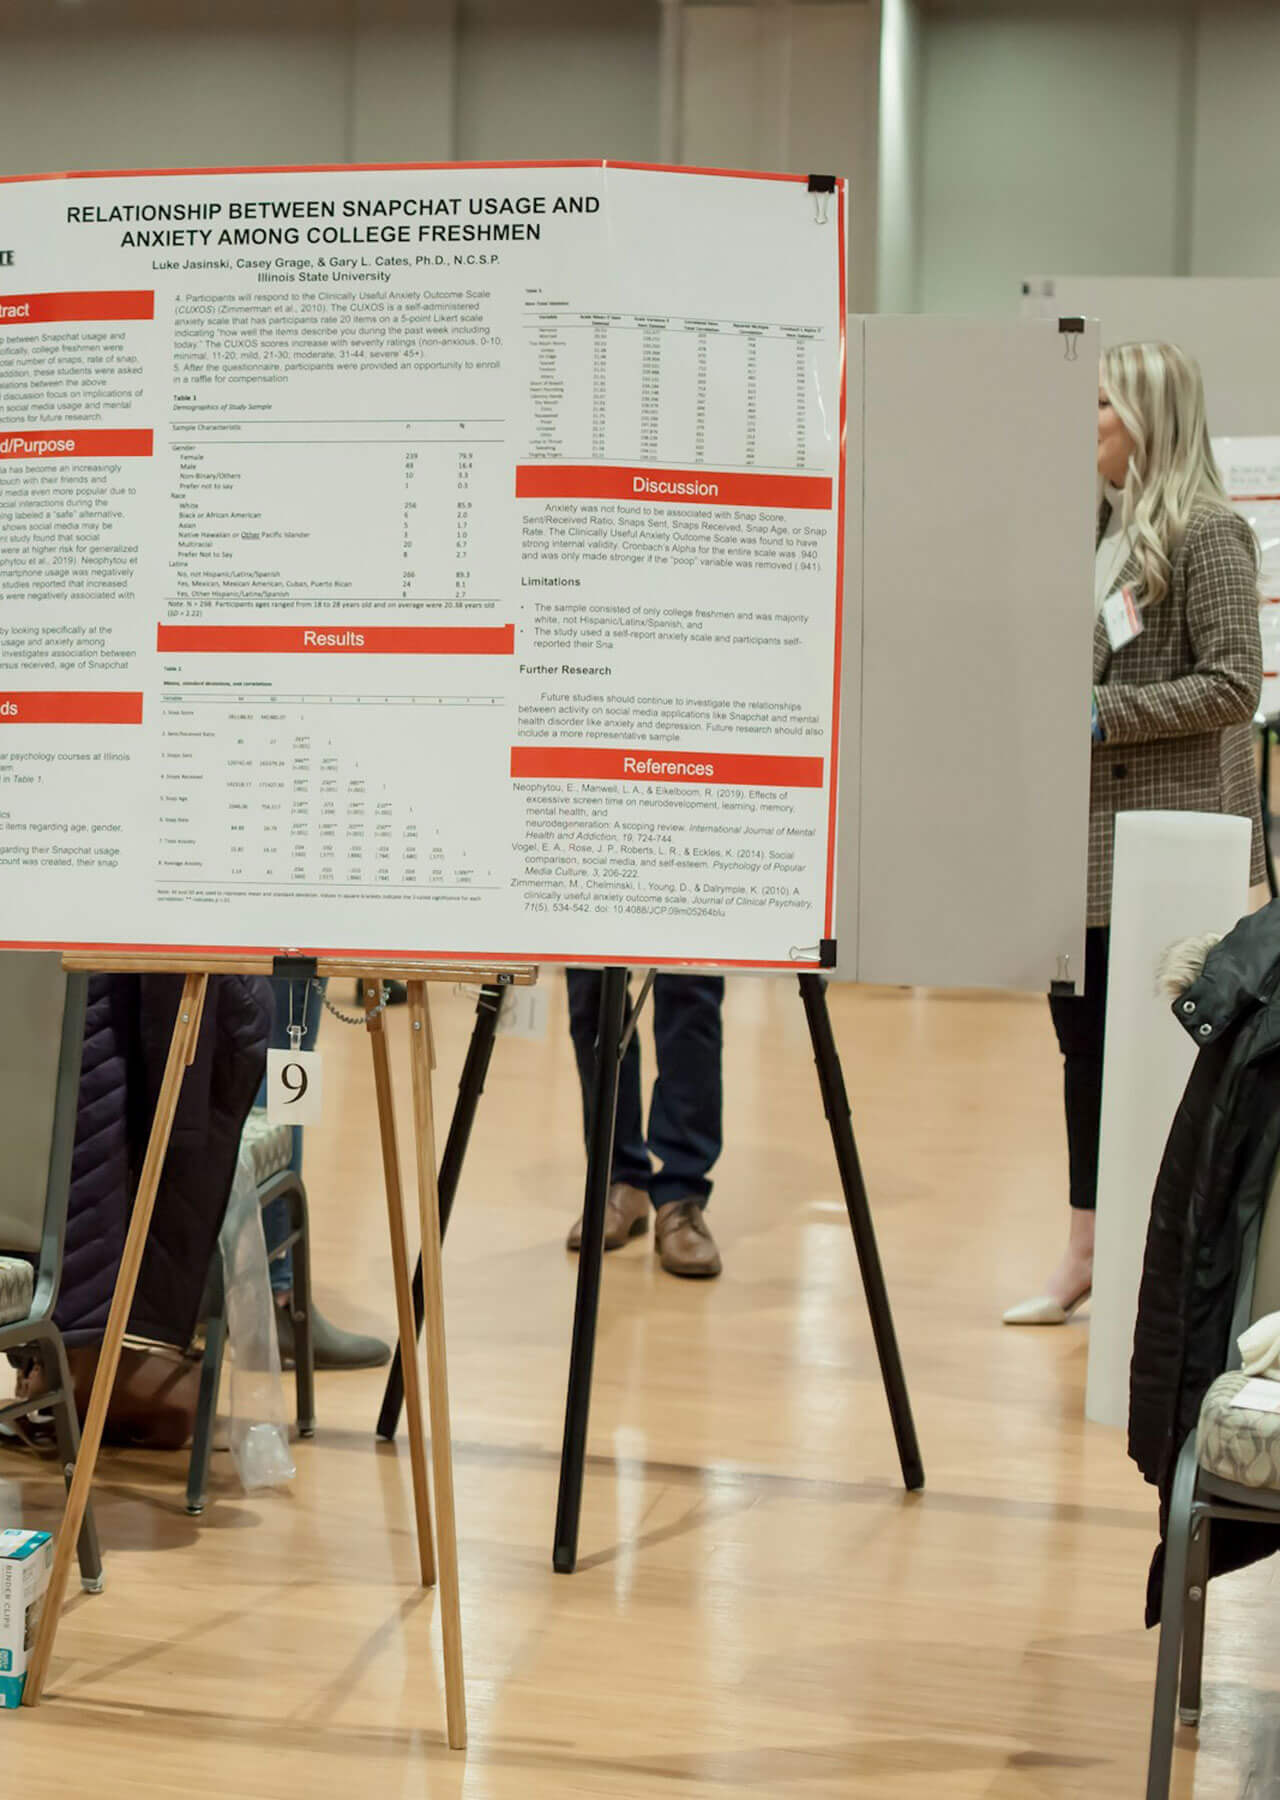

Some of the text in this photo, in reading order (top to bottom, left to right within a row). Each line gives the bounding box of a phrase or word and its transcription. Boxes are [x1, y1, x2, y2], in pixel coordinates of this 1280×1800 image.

[67, 197, 600, 222] RELATIONSHIP BETWEEN SNAPCHAT USAGE AND
[120, 224, 541, 247] ANXIETY AMONG COLLEGE FRESHMEN
[152, 258, 179, 269] Luke
[182, 258, 232, 271] Jasinski,
[236, 258, 271, 271] Casey
[274, 257, 313, 270] Grage,
[317, 257, 325, 267] &
[328, 256, 357, 269] Gary
[360, 256, 371, 266] L.
[374, 255, 412, 268] Cates,
[453, 254, 502, 264] N.C.S.P.
[258, 269, 392, 283] Illinois State University
[174, 316, 204, 327] anxiety
[207, 316, 229, 324] scale
[231, 316, 248, 324] that
[250, 315, 266, 324] has
[268, 315, 318, 325] participants
[352, 314, 376, 322] items
[400, 314, 431, 324] 5-point
[433, 313, 457, 322] Likert
[459, 313, 483, 321] scale
[6, 334, 39, 343] between
[41, 332, 79, 344] Snapchat
[81, 333, 107, 342] usage
[109, 331, 125, 339] and
[633, 476, 718, 496] Discussion
[545, 503, 577, 514] Anxiety
[616, 505, 641, 514] found
[653, 507, 664, 515] be
[666, 507, 712, 518] associated
[714, 510, 731, 519] with
[733, 511, 756, 522] Snap
[522, 515, 587, 524] Sent/Received
[617, 517, 644, 528] Snaps
[672, 519, 699, 530] Snaps
[745, 523, 768, 534] Snap
[803, 525, 827, 536] Snap
[549, 527, 565, 535] The
[567, 527, 607, 538] Clinically
[609, 528, 637, 537] Useful
[639, 529, 670, 541] Anxiety
[672, 531, 711, 541] Outcome
[713, 533, 737, 542] Scale
[759, 535, 783, 544] found
[795, 537, 818, 546] have
[31, 545, 56, 555] higher
[58, 544, 73, 553] risk
[88, 544, 138, 554] generalized
[520, 577, 581, 586] Limitations
[535, 603, 551, 611] The
[554, 603, 586, 614] sample
[588, 604, 630, 613] consisted
[632, 605, 640, 613] of
[642, 605, 660, 616] only
[662, 606, 693, 618] college
[695, 608, 734, 618] freshmen
[736, 610, 753, 619] and
[774, 612, 809, 623] majority
[304, 630, 365, 646] Results
[520, 664, 612, 676] Further Research
[518, 704, 556, 712] between
[558, 704, 588, 715] activity
[605, 706, 630, 715] social
[632, 707, 658, 716] media
[660, 708, 710, 720] applications
[712, 710, 726, 719] like
[729, 711, 768, 723] Snapchat
[771, 713, 787, 721] and
[789, 713, 819, 723] mental
[9, 752, 55, 762] psychology
[103, 752, 130, 760] Illinois
[624, 757, 714, 776] References
[582, 855, 607, 864] social
[640, 857, 656, 865] and
[712, 860, 760, 872] Psychology
[762, 861, 771, 870] of
[773, 862, 806, 873] Popular
[282, 1063, 308, 1104] 9
